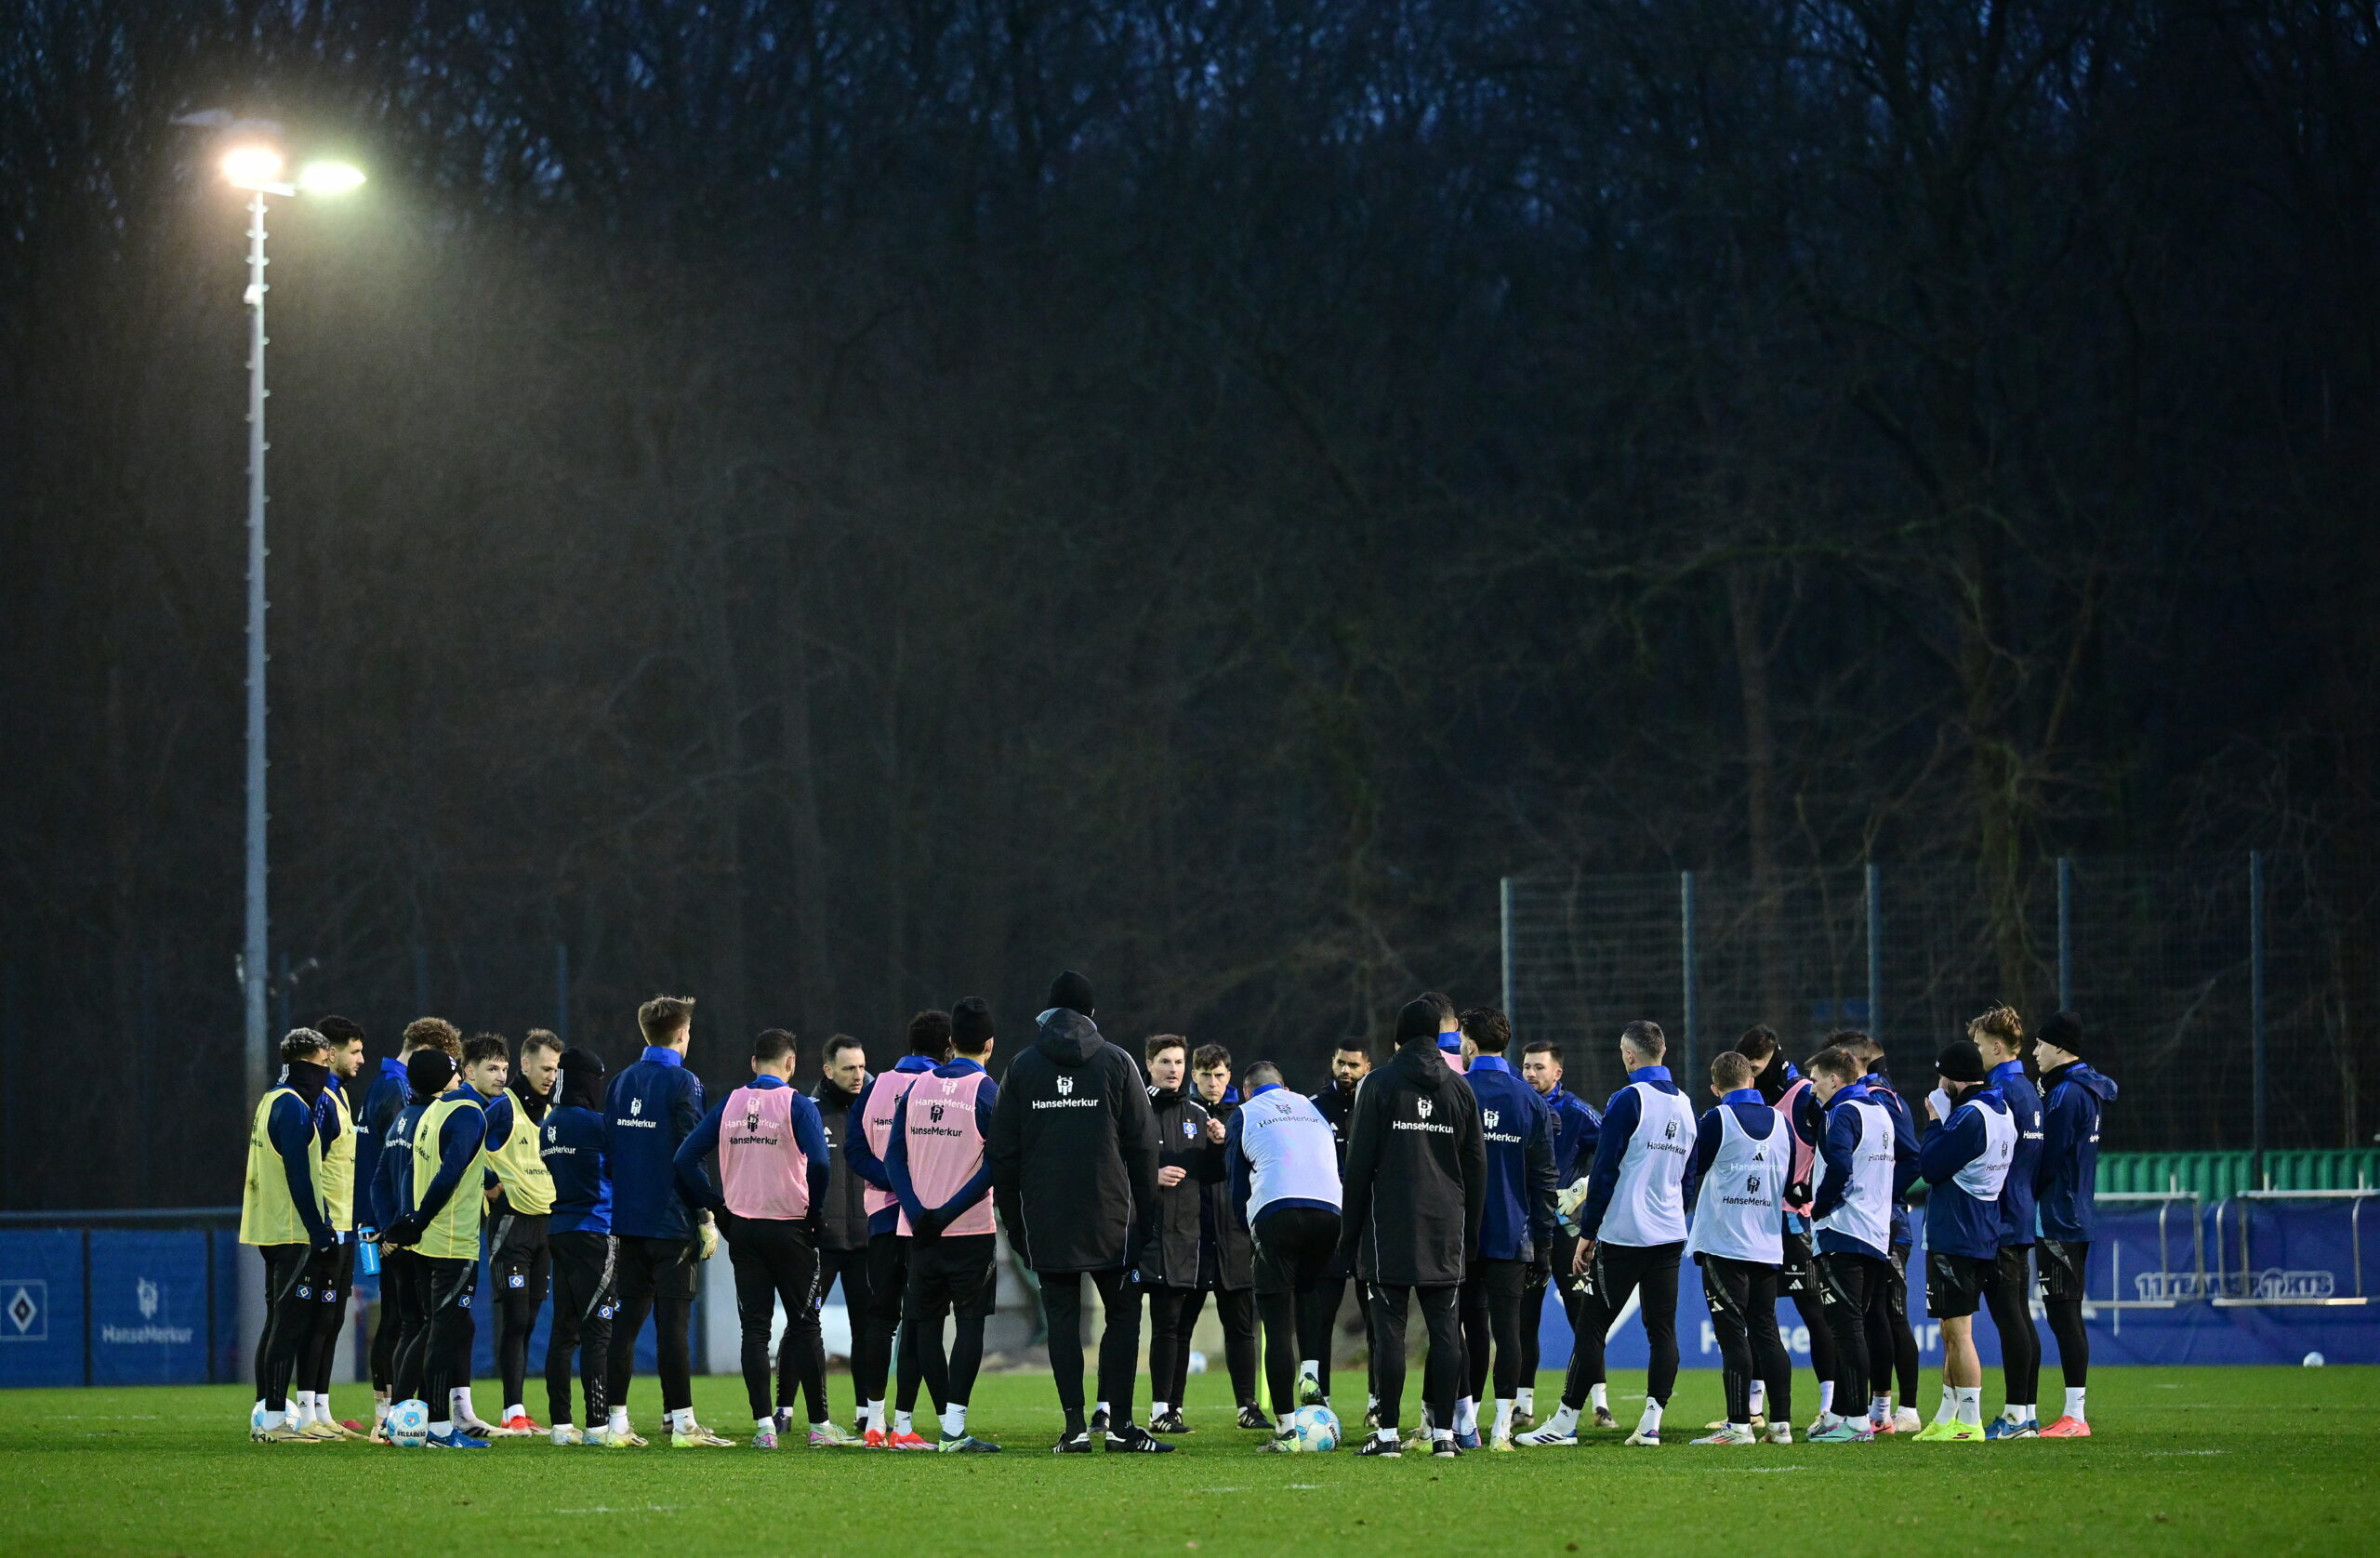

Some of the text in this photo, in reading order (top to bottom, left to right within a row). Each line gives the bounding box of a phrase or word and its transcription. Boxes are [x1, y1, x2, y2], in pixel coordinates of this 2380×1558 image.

[1032, 1098, 1099, 1110] HanseMerkur
[616, 1118, 657, 1129] anseMerkur
[725, 1118, 780, 1129] Hanserkur
[1258, 1116, 1320, 1129] HanseMerkur
[910, 1126, 963, 1137] HanseMerkur
[1483, 1131, 1522, 1143] eMerkur
[1722, 1195, 1772, 1208] HanseMerku
[101, 1324, 193, 1344] HanseMerkur
